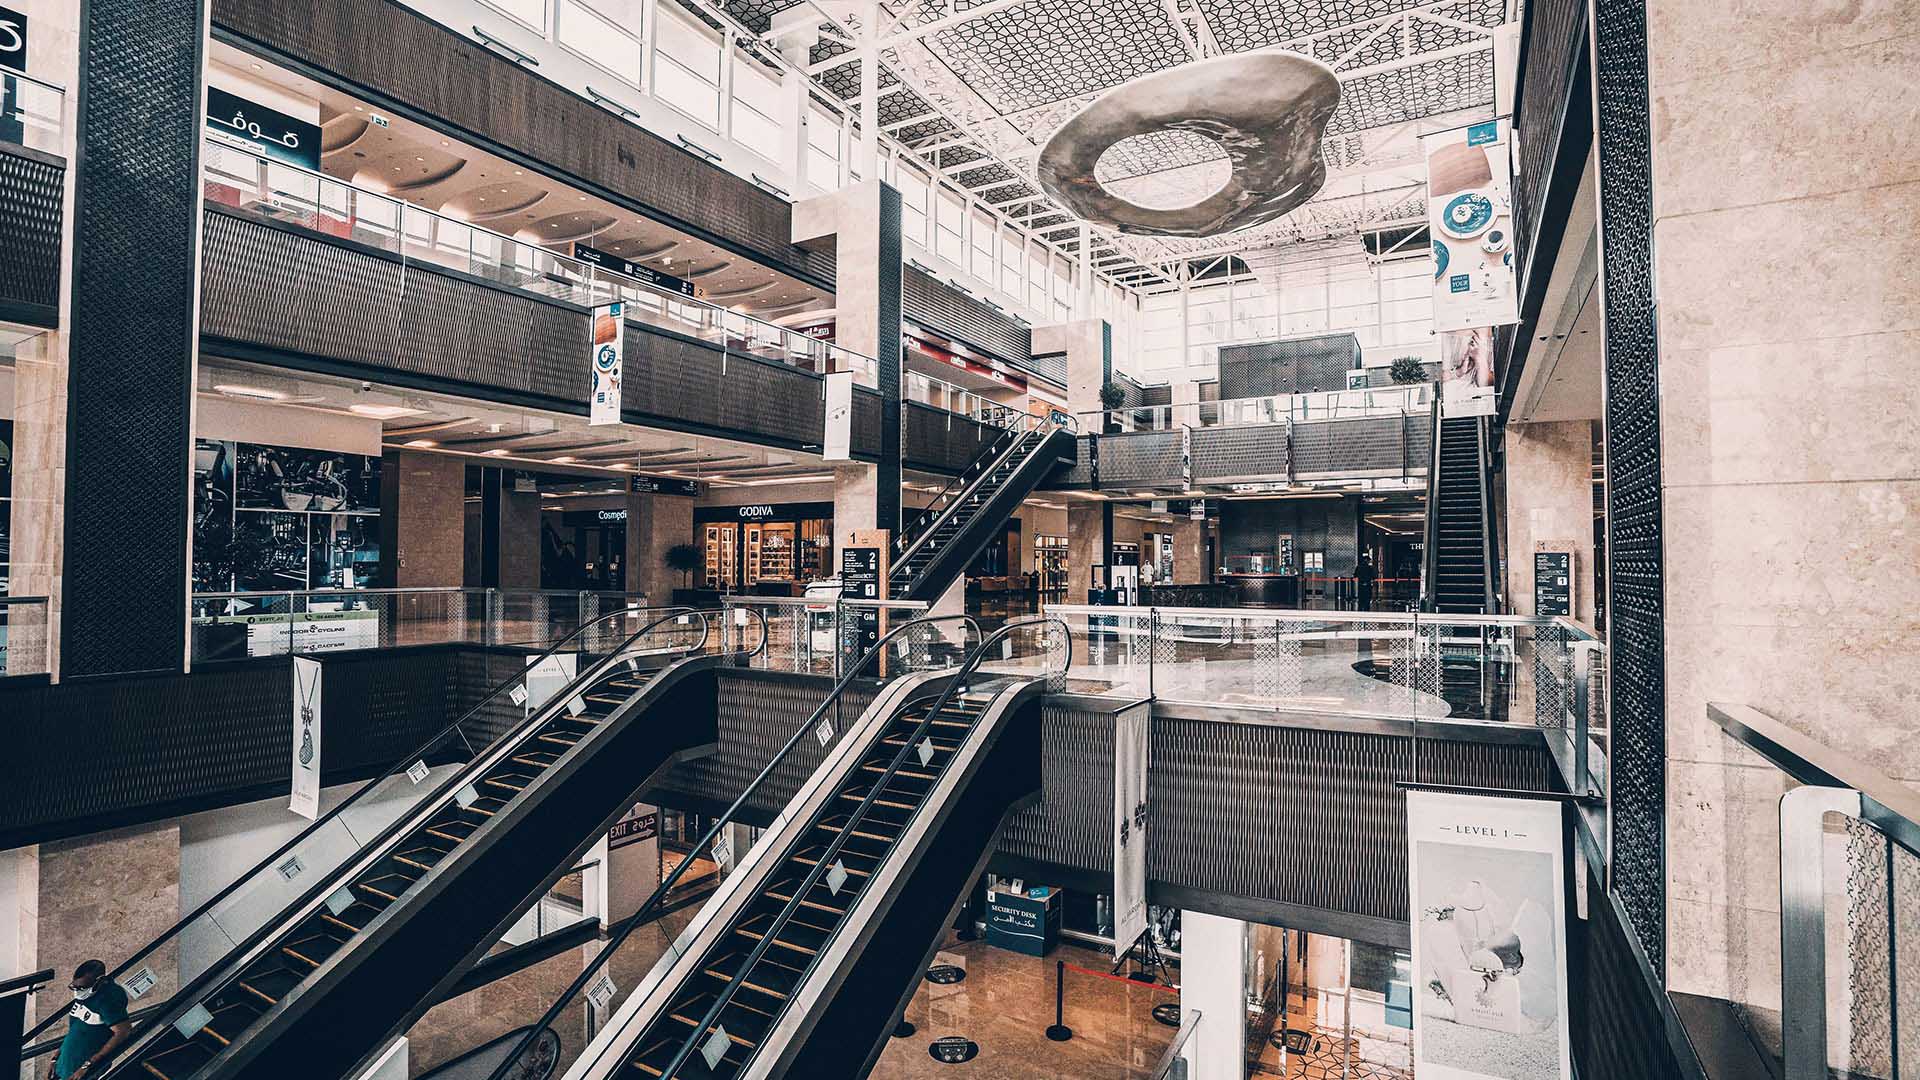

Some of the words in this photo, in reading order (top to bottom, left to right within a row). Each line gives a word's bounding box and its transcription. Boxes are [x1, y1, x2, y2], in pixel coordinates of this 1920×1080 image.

[739, 505, 774, 517] GODIVA
[850, 532, 856, 544] 1
[869, 552, 876, 563] 2
[863, 613, 876, 621] GM
[869, 631, 876, 640] G
[632, 816, 655, 831] خروج
[610, 823, 628, 838] EXIT
[1456, 825, 1497, 837] LEVEL
[991, 904, 1020, 916] SECURITY
[1021, 911, 1037, 920] DESK
